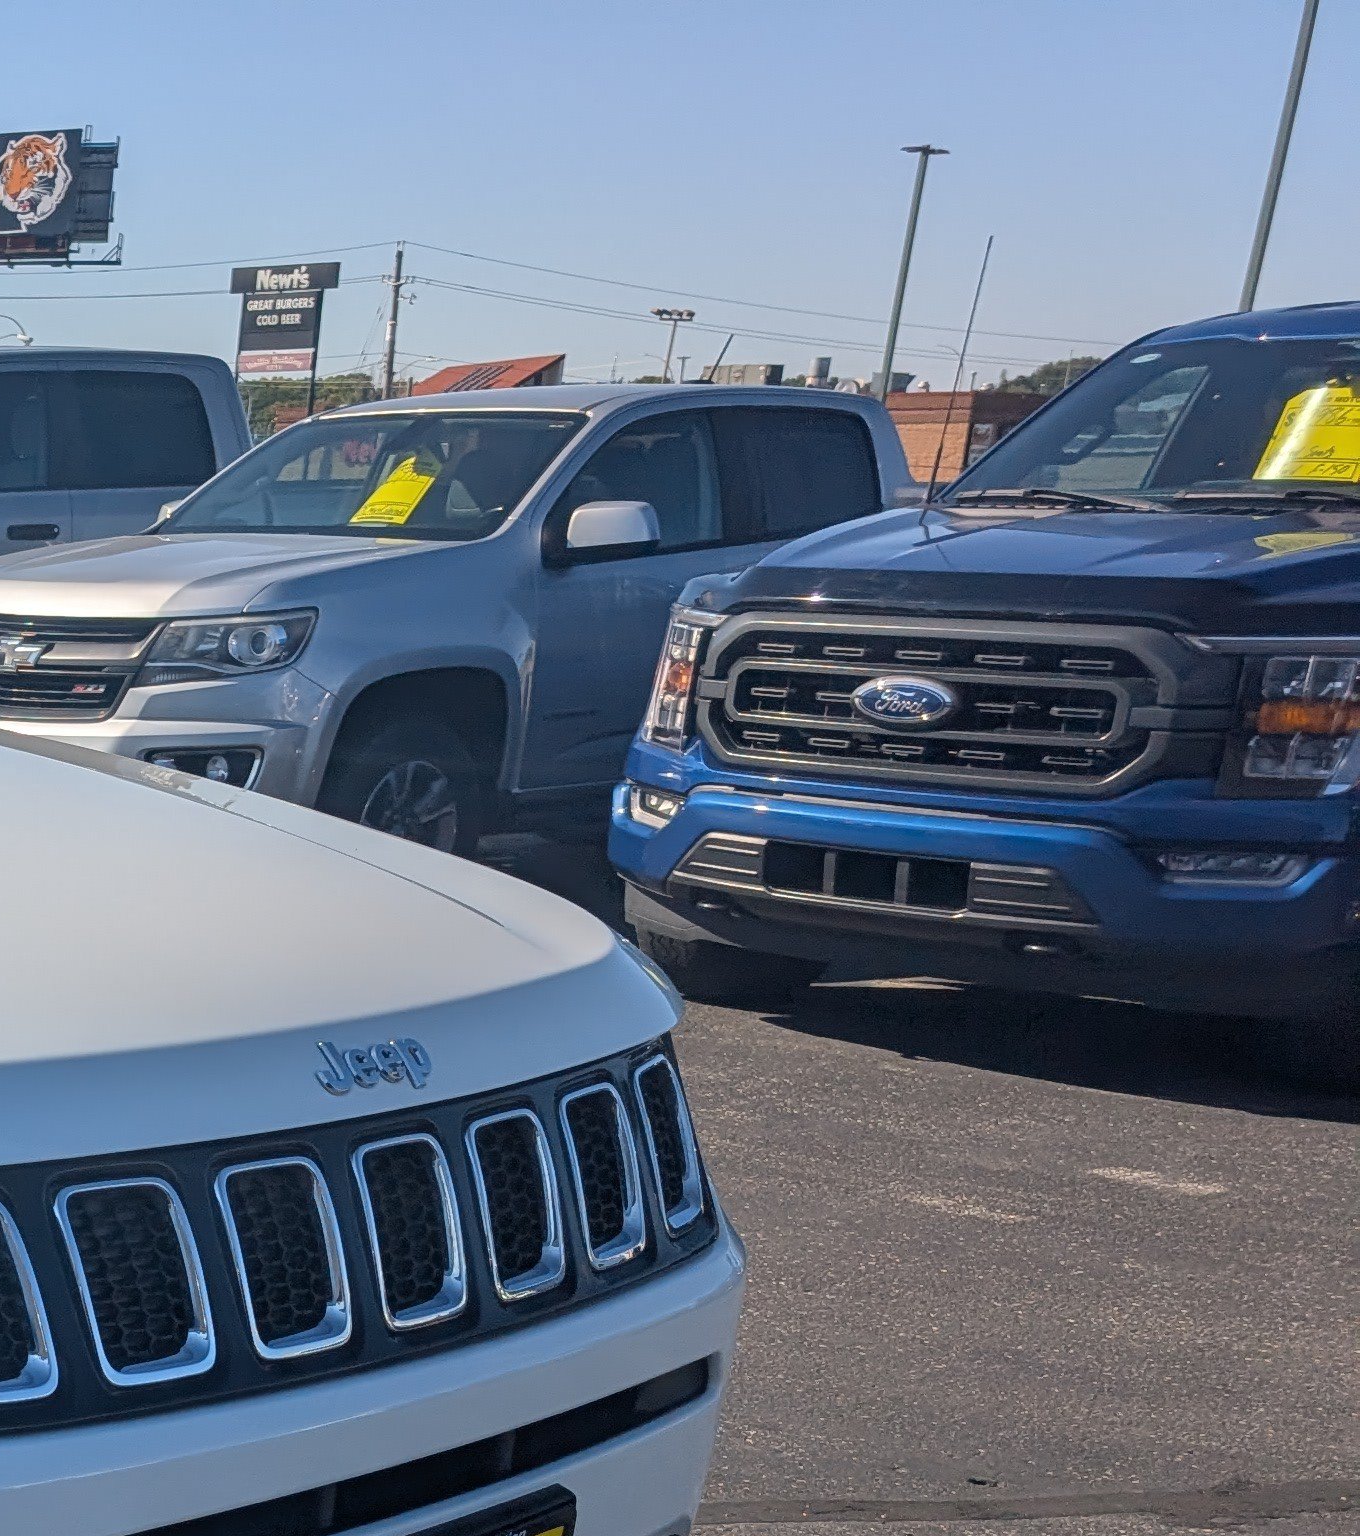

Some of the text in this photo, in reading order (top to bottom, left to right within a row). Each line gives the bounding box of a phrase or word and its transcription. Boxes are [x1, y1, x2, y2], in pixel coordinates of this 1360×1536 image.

[256, 265, 310, 290] Newt's
[246, 297, 315, 312] GREAT BURGERS
[256, 313, 302, 326] COLD BEER
[875, 688, 928, 714] Ford
[314, 1037, 432, 1096] Jeep
